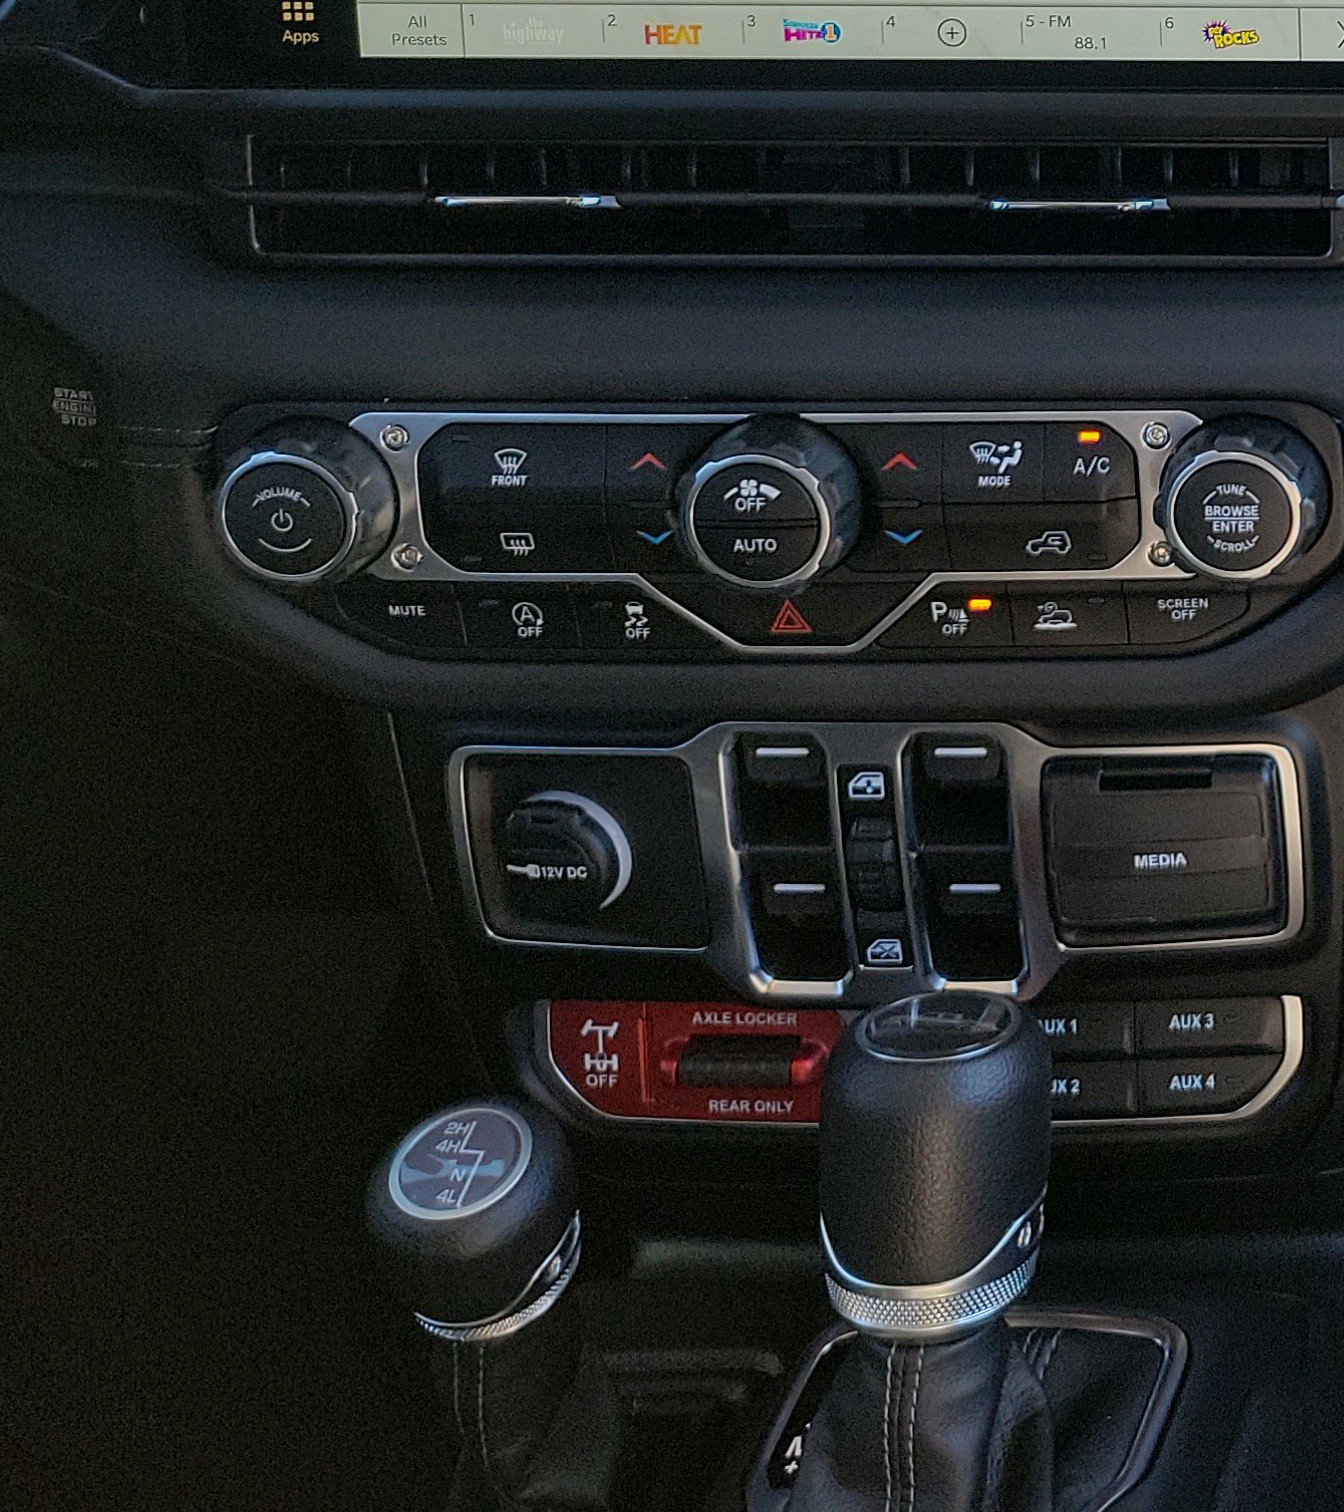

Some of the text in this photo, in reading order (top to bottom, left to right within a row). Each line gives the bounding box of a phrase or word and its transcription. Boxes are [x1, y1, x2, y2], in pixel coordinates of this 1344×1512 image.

[408, 15, 427, 28] All
[747, 15, 756, 27] 3
[885, 15, 895, 27] 4
[1026, 15, 1072, 28] 5 FM
[1165, 17, 1175, 29] 6
[607, 14, 702, 46] 2 HEAT
[282, 29, 319, 45] Apps
[391, 32, 447, 47] Presets
[1074, 35, 1107, 50] 88.1
[1073, 456, 1111, 476] A/C
[491, 474, 528, 487] FRONT
[978, 475, 1012, 487] MODE
[255, 488, 303, 503] VOLUME
[1216, 484, 1247, 497] TUNE
[734, 497, 766, 513] OFF
[1204, 504, 1259, 518] BROWSE
[1212, 520, 1255, 534] ENTER
[733, 537, 777, 553] AUTO
[1213, 536, 1255, 552] SCROLL
[388, 605, 426, 617] MUTE
[1158, 598, 1209, 611] SCREEN
[1171, 608, 1196, 620] OFF
[517, 625, 543, 637] OFF
[625, 627, 651, 640] OFF
[942, 622, 968, 635] OFF
[1134, 853, 1187, 868] MEDIA
[541, 865, 587, 878] 12V DC
[692, 1012, 797, 1025] AXLE LOCKER
[1169, 1014, 1214, 1029] AUX 3
[1070, 1019, 1077, 1033] 1
[586, 1074, 618, 1087] OFF
[1070, 1079, 1080, 1093] 2
[1169, 1074, 1216, 1090] AUX 4
[708, 1099, 794, 1113] REAR ONLY
[444, 1123, 470, 1135] 2H
[436, 1140, 461, 1153] 4H
[450, 1169, 466, 1181] N
[436, 1189, 457, 1202] 4L
